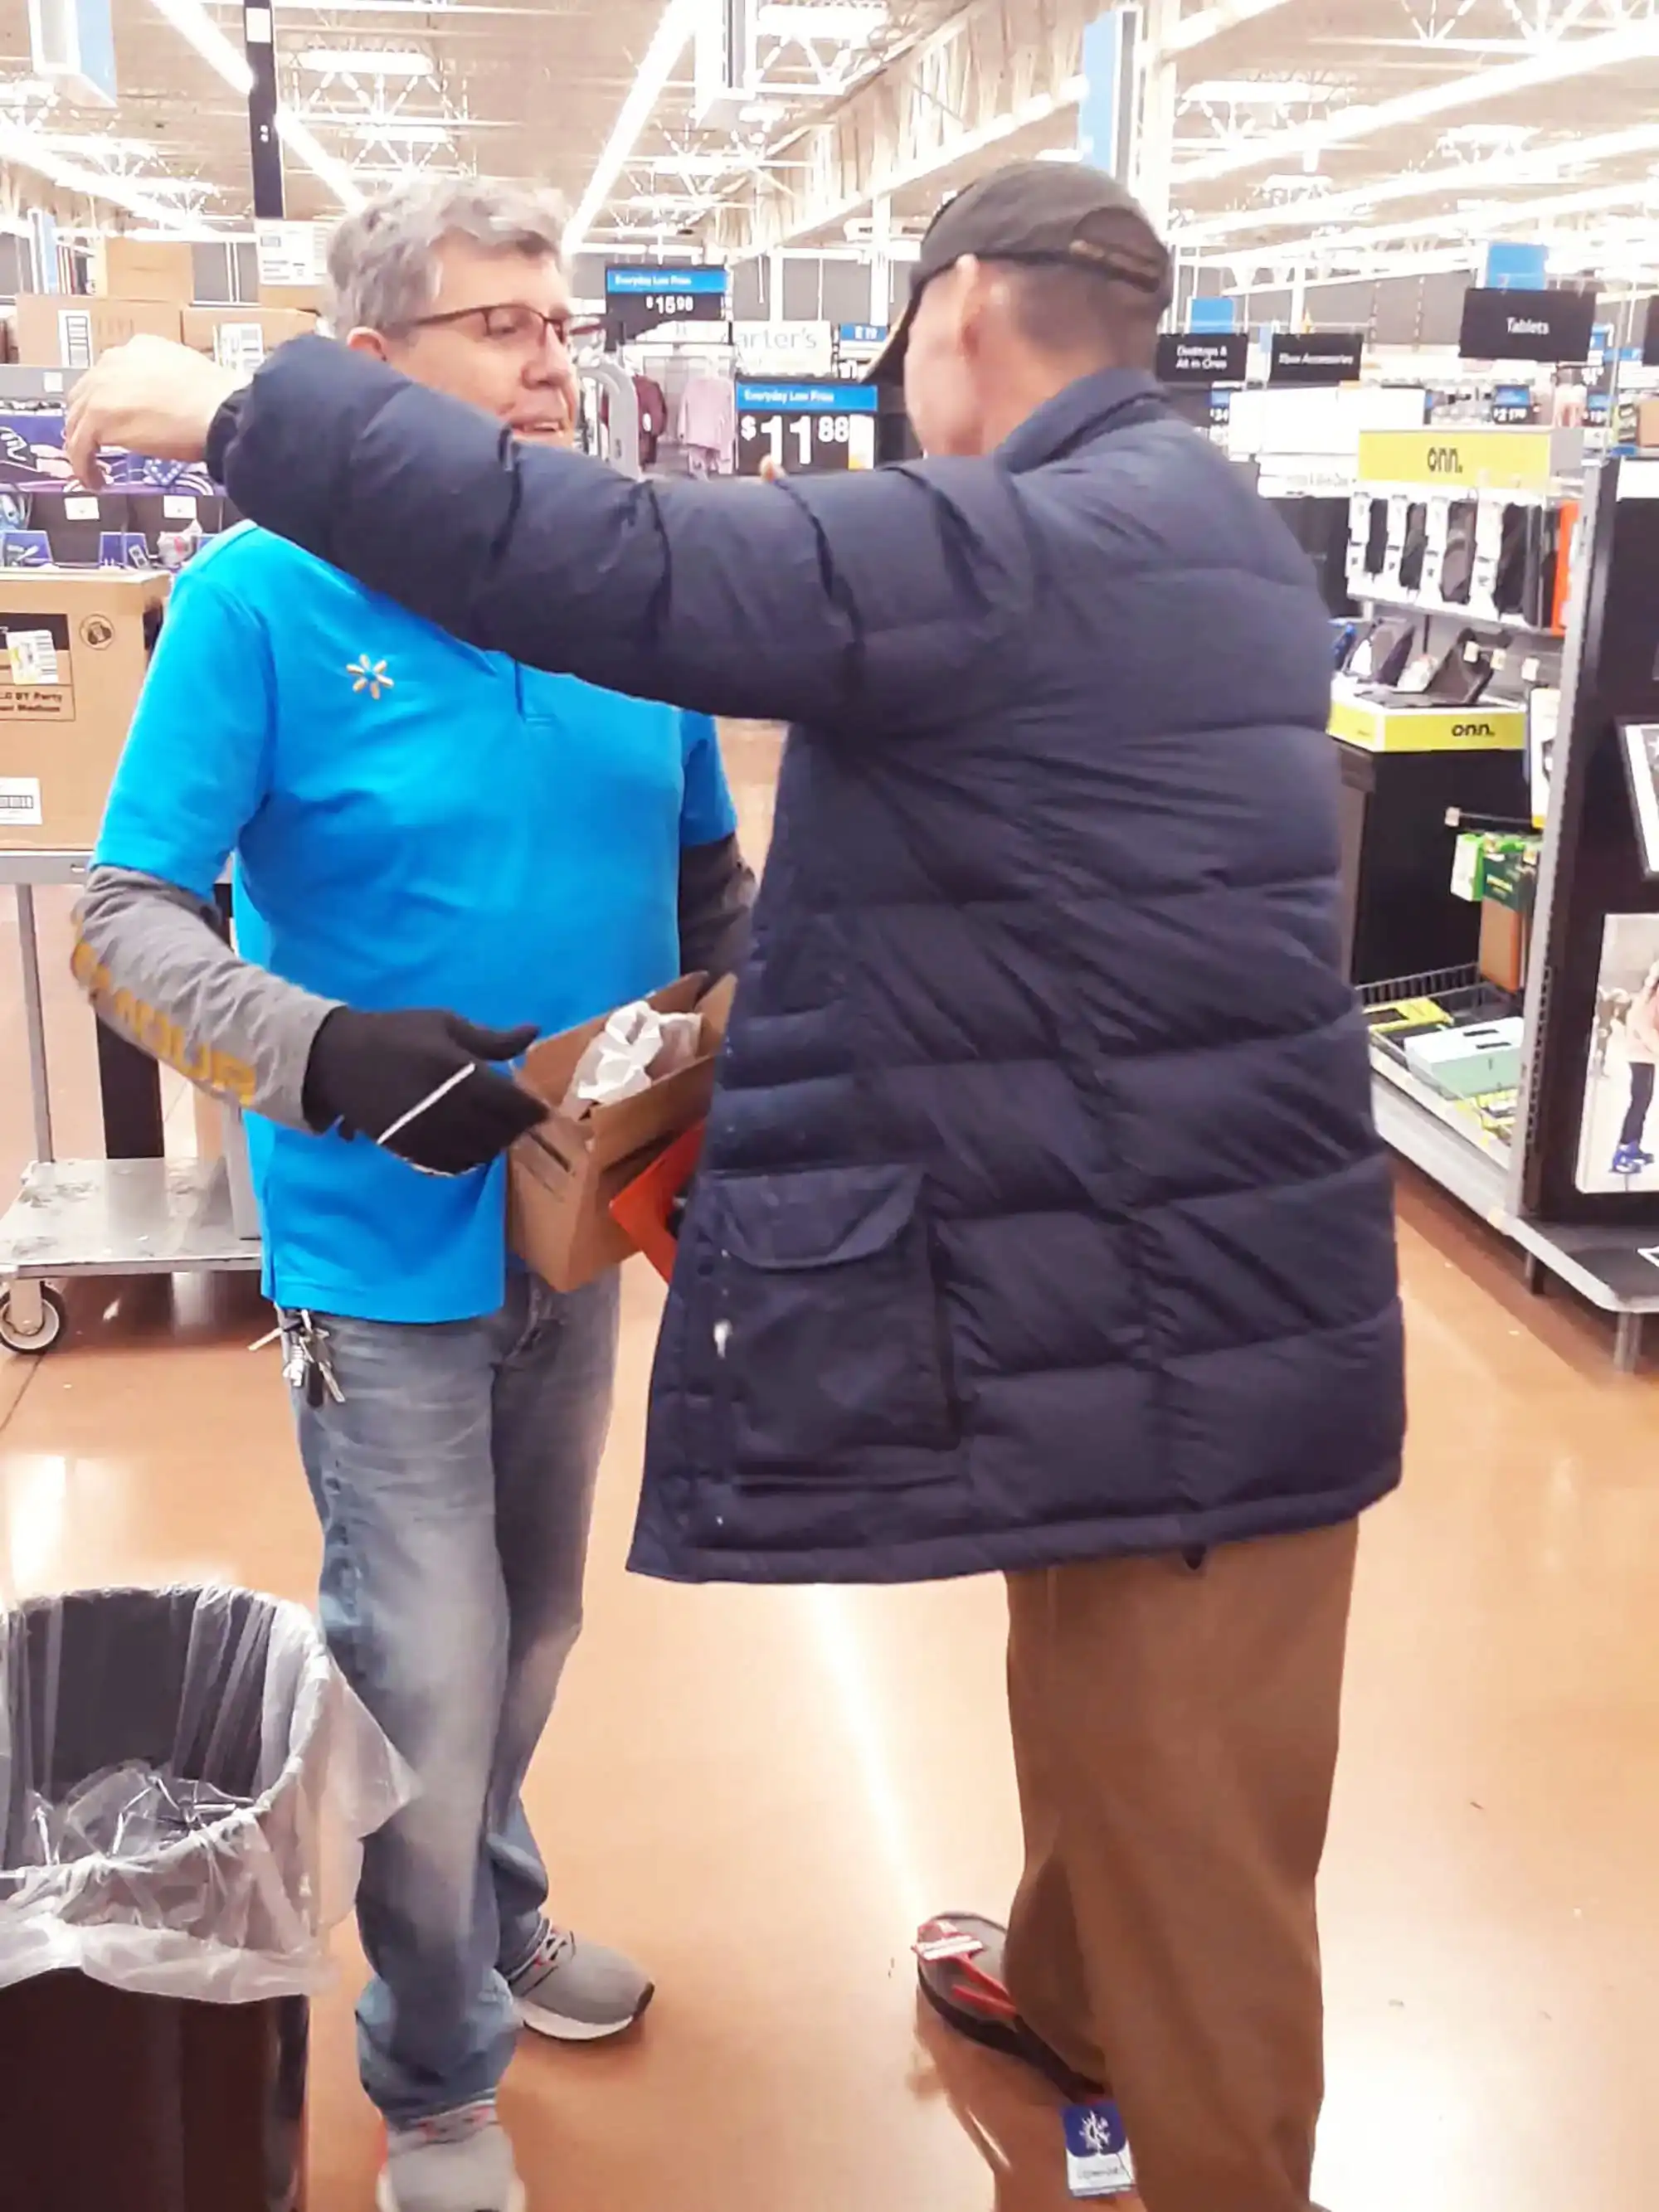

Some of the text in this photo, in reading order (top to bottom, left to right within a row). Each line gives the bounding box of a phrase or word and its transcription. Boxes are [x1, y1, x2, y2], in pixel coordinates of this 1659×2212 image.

[1506, 317, 1550, 334] Tablets
[721, 327, 817, 349] arter's
[744, 389, 834, 404] Everyday Low Price
[1427, 447, 1463, 474] onn.
[1452, 723, 1495, 737] onn.
